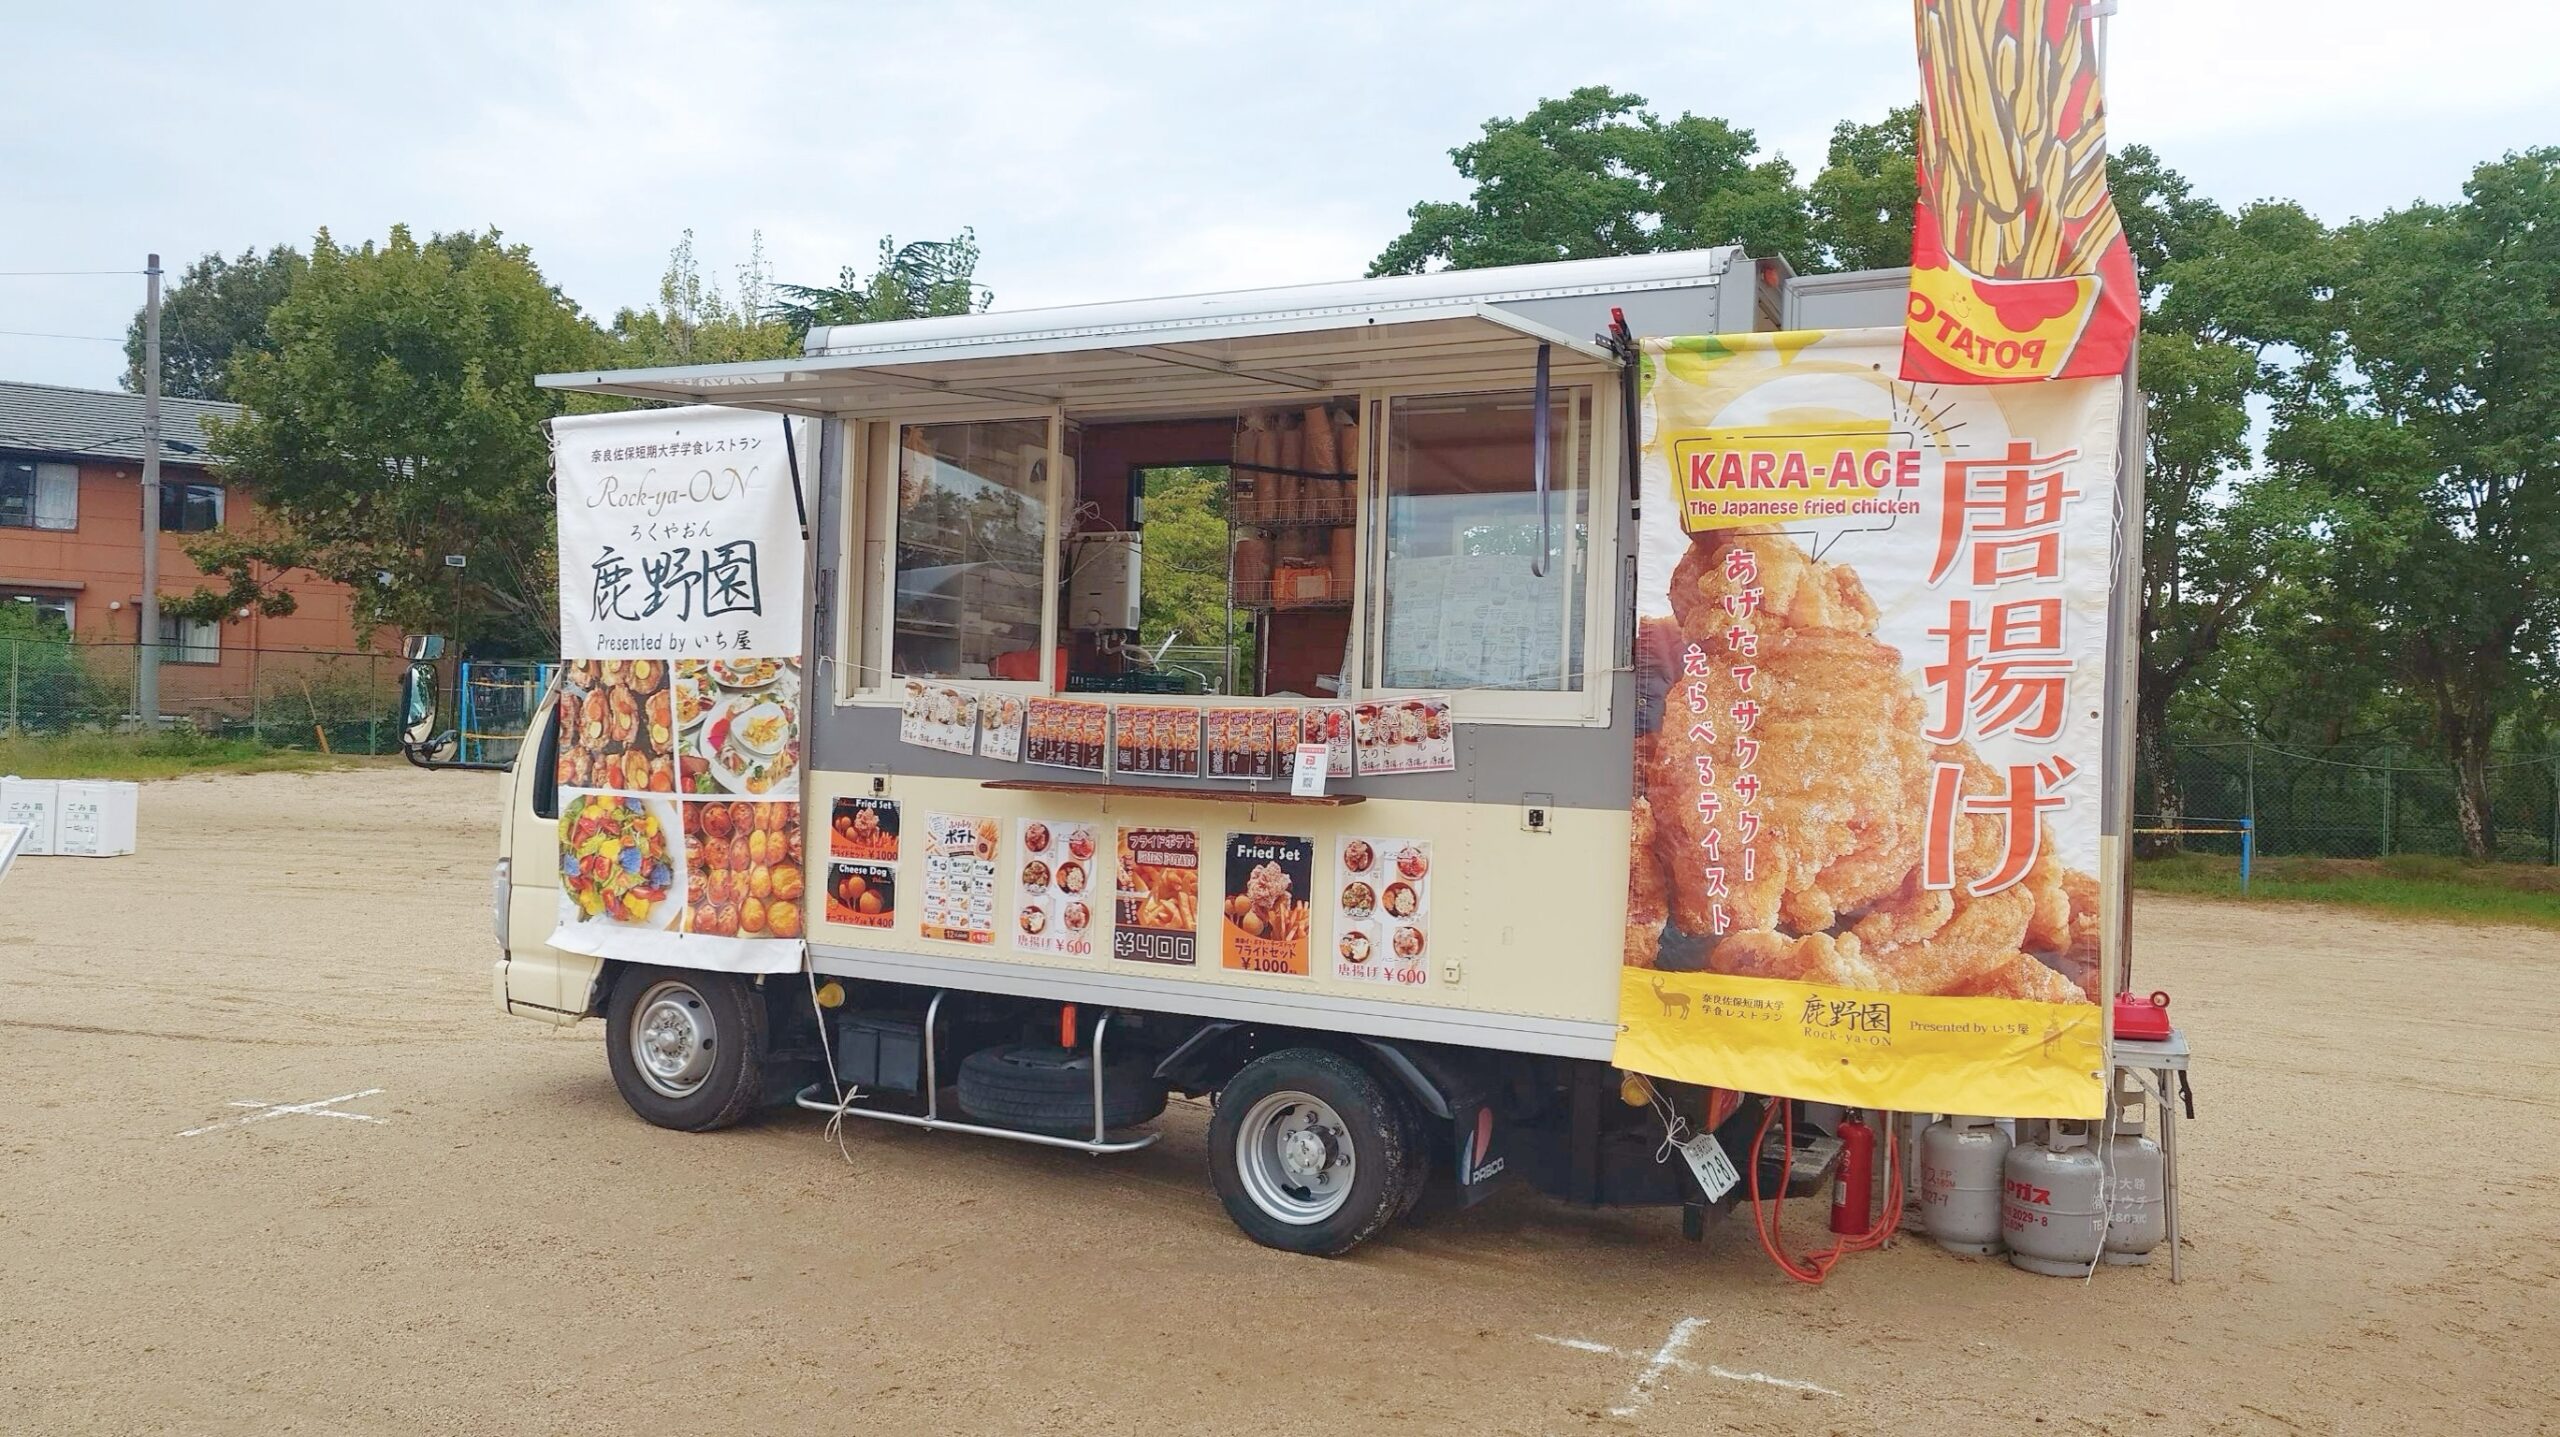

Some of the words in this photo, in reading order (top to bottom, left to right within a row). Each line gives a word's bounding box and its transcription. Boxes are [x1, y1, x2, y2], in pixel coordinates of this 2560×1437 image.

[590, 437, 762, 463] 奈良佐保短期大学学食レストラン
[1690, 451, 1921, 489] KARA-AGE
[1690, 500, 1717, 515] The
[1722, 499, 1798, 518] Japanese
[1804, 499, 1846, 515] fried
[1852, 499, 1921, 515] chicken
[630, 520, 713, 541] ろくやおん
[590, 540, 762, 622] 鹿野園
[597, 634, 661, 651] Presented
[670, 634, 686, 652] by
[695, 631, 752, 650] いち屋
[1922, 437, 2083, 898] 唐揚げ
[1682, 642, 1731, 936] えらべるテイスト
[856, 799, 877, 808] Fried
[879, 801, 892, 810] Set
[944, 829, 976, 844] ポテト
[1129, 835, 1194, 849] フライドポテト
[1237, 845, 1274, 860] Fried
[1279, 847, 1300, 862] Set
[839, 864, 868, 875] Cheese
[870, 867, 888, 878] Dog
[1056, 938, 1091, 955] ¥600
[1116, 932, 1194, 962] ¥400
[1235, 945, 1296, 959] フライドセット
[1241, 957, 1288, 973] ¥1000
[1338, 964, 1378, 979] 唐揚げ
[1384, 967, 1427, 984] ¥600
[1702, 992, 1785, 1011] 奈良佐保短期大学
[1702, 1004, 1784, 1023] 学食レストラン
[1800, 993, 1891, 1034] 鹿野園
[1909, 1021, 1970, 1034] Presented
[1974, 1021, 1988, 1036] by
[1991, 1022, 2030, 1036] いち屋
